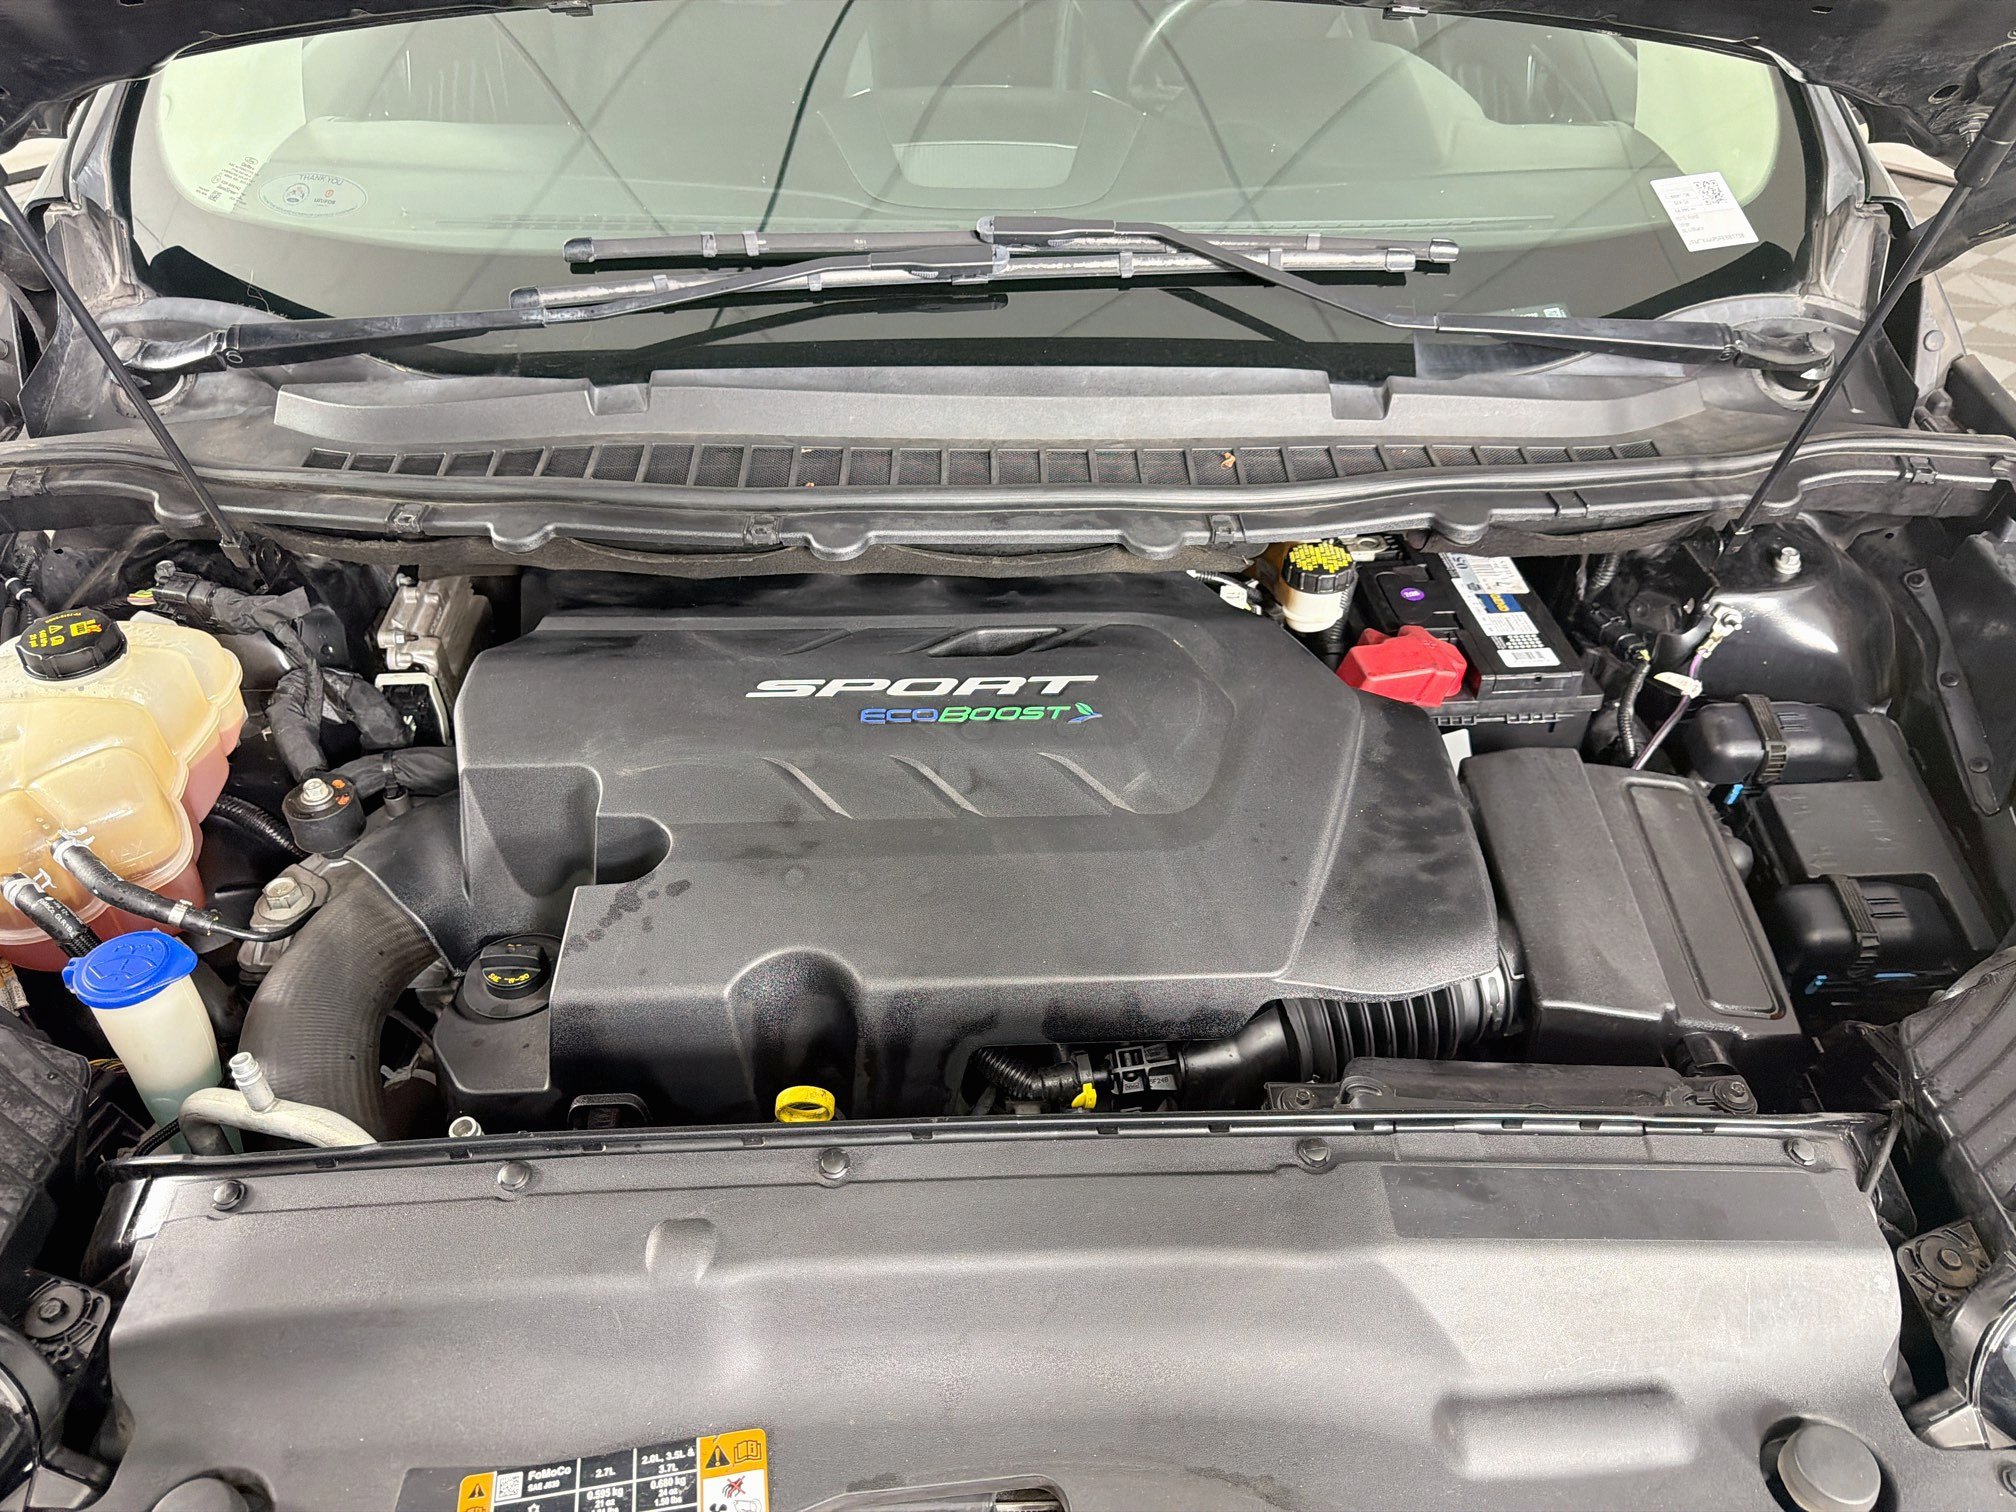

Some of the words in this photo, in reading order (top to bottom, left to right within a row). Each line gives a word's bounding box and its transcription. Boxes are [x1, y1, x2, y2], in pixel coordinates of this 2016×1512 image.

[299, 174, 328, 184] THANK
[327, 176, 344, 187] YOU
[745, 675, 1099, 698] SPORT
[641, 1454, 665, 1465] 2.0L,
[666, 1450, 686, 1460] 3.5L
[687, 1446, 695, 1457] &
[527, 1465, 572, 1481] FoMoCo
[594, 1466, 616, 1478] 2.7L
[658, 1463, 679, 1473] 3.7L
[674, 1476, 687, 1486] kg
[527, 1482, 543, 1492] SAE
[668, 1487, 678, 1496] oz
[586, 1488, 611, 1500] 0.595
[612, 1486, 624, 1498] kg
[594, 1500, 604, 1509] 21
[605, 1498, 616, 1507] oz
[670, 1495, 683, 1505] lbs
